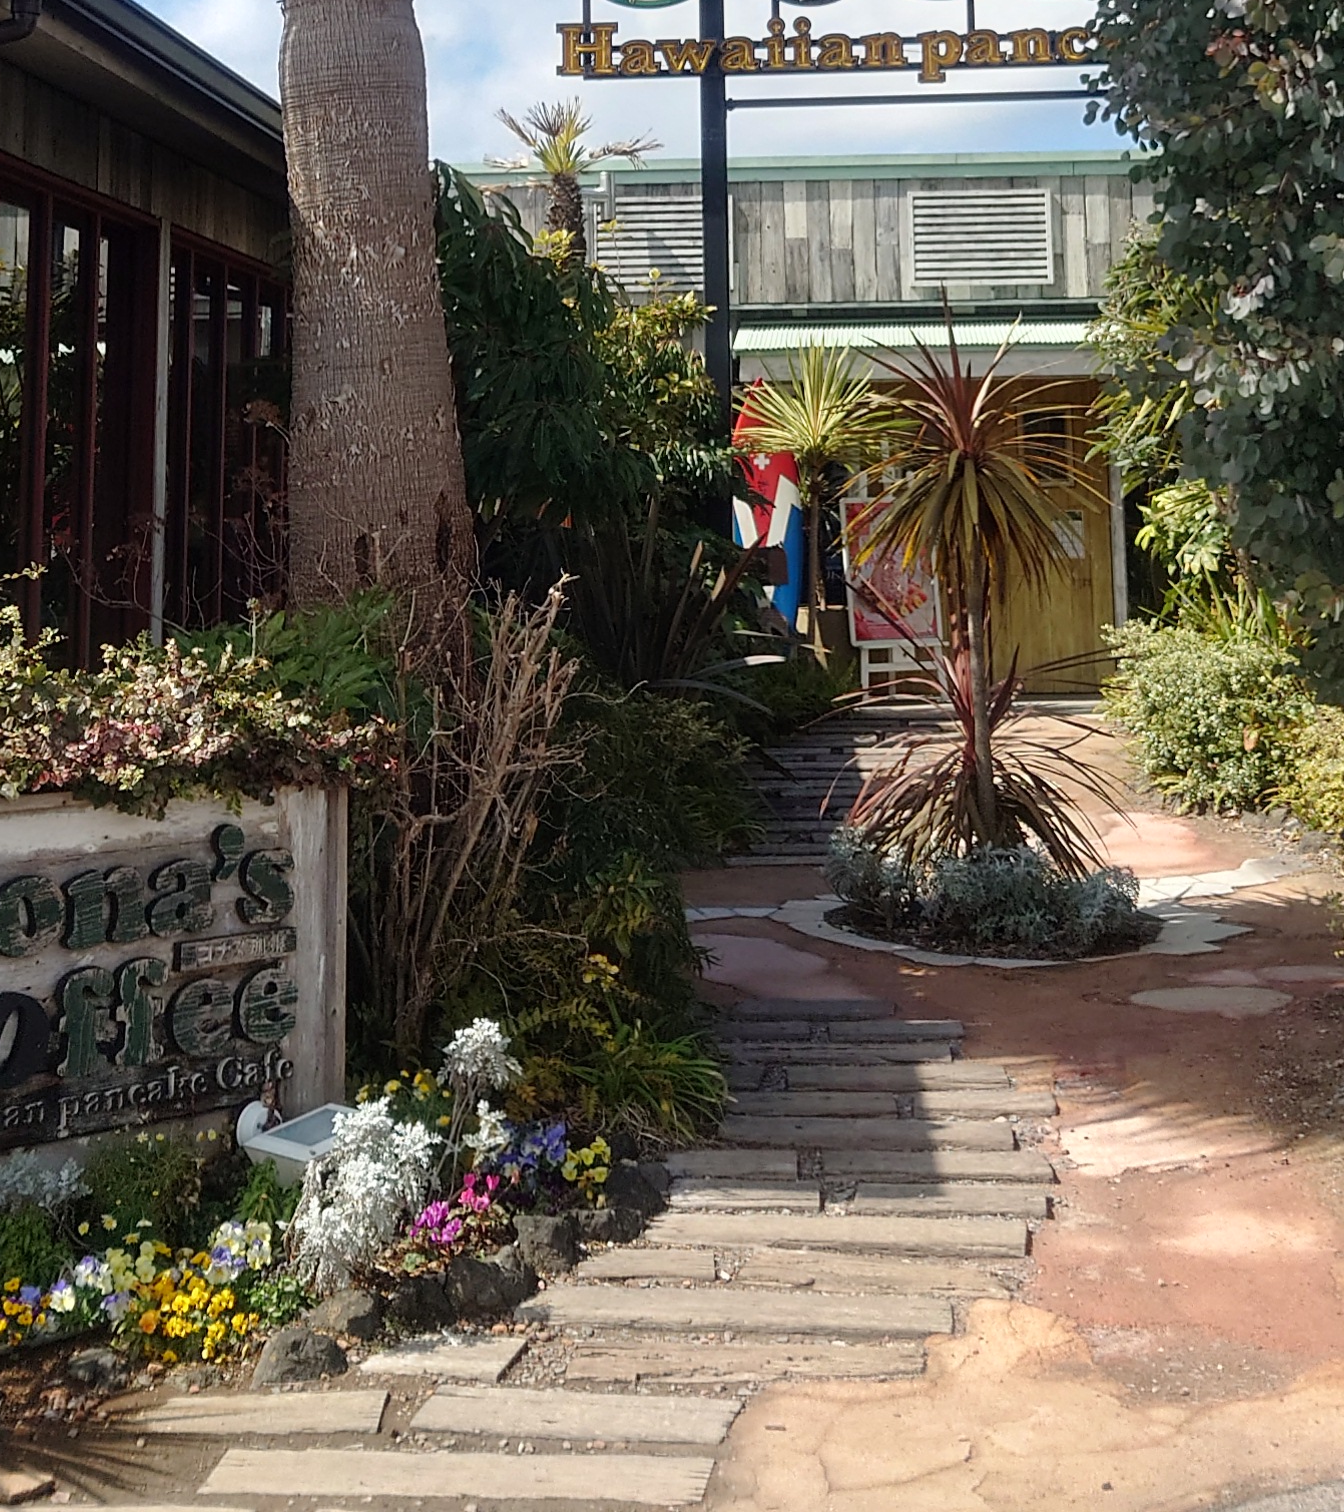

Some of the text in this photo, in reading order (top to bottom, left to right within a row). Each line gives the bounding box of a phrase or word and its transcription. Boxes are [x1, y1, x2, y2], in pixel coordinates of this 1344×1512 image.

[555, 16, 1096, 83] Hawaiian panc
[58, 1064, 208, 1138] pancake
